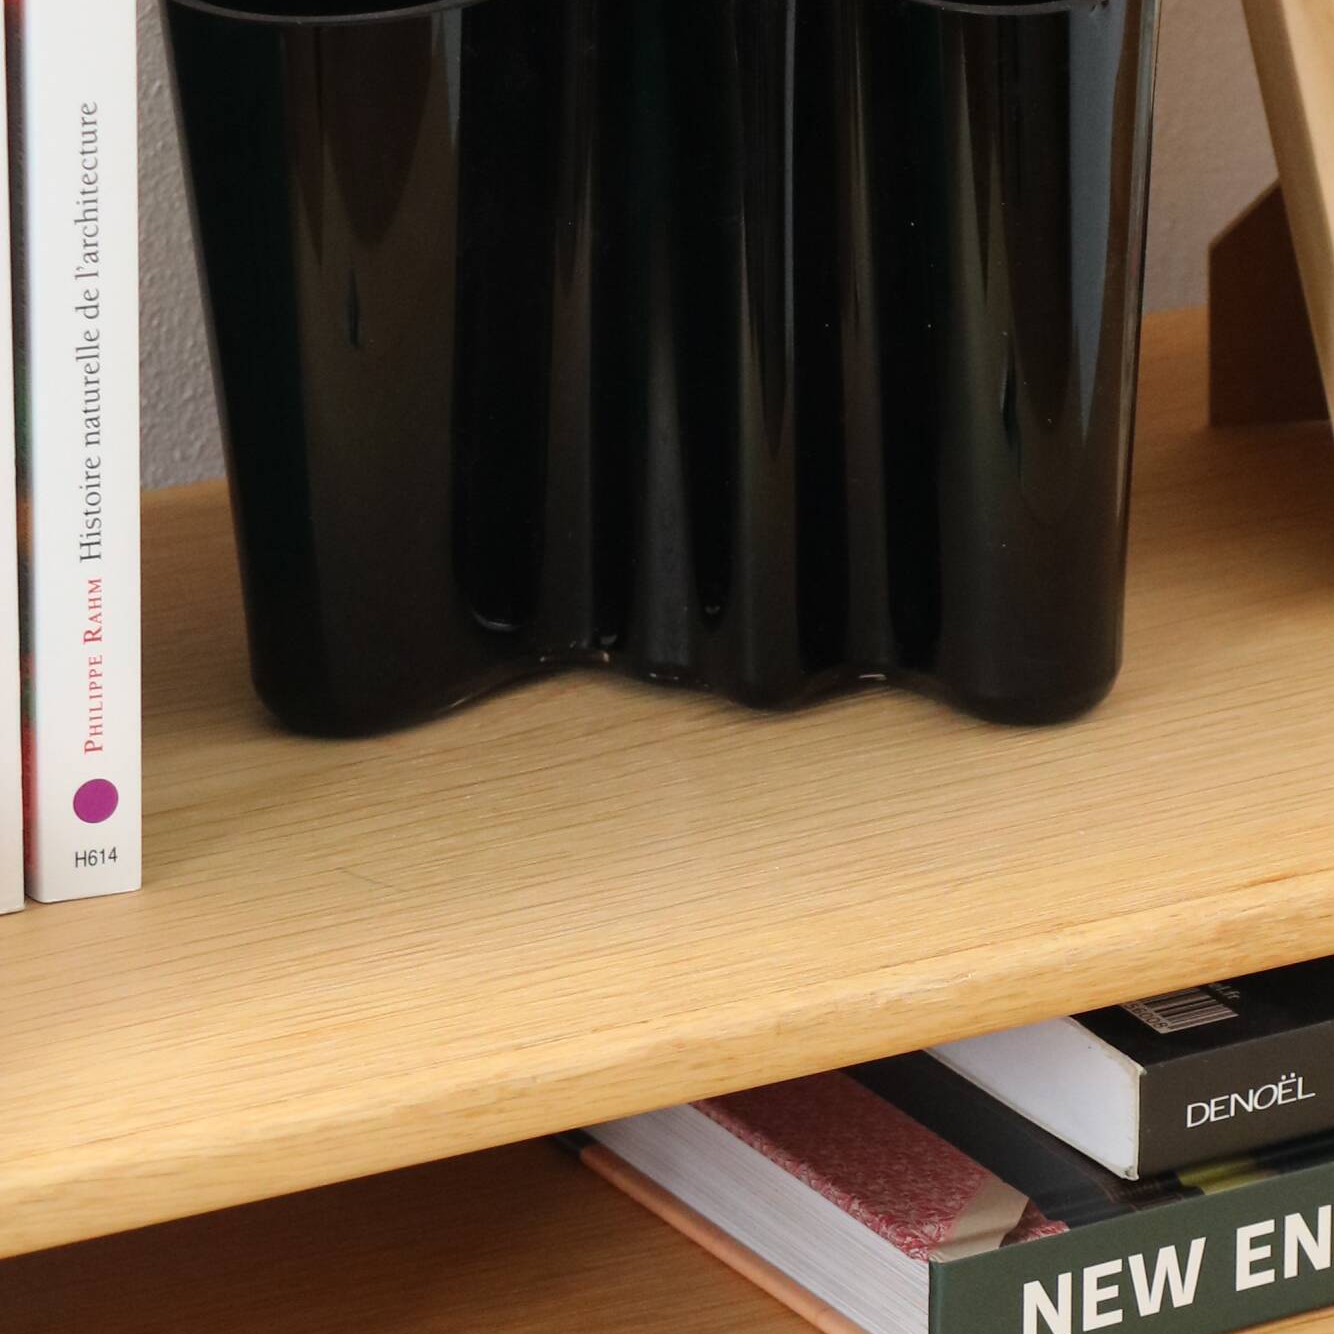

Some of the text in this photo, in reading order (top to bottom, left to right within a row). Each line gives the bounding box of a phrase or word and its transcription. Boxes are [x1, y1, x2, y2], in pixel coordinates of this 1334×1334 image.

[74, 101, 103, 754] PHILIPPE RAHM Histoire naturelle de l'architecture
[75, 847, 118, 868] H614
[1186, 1072, 1317, 1128] DENOËL
